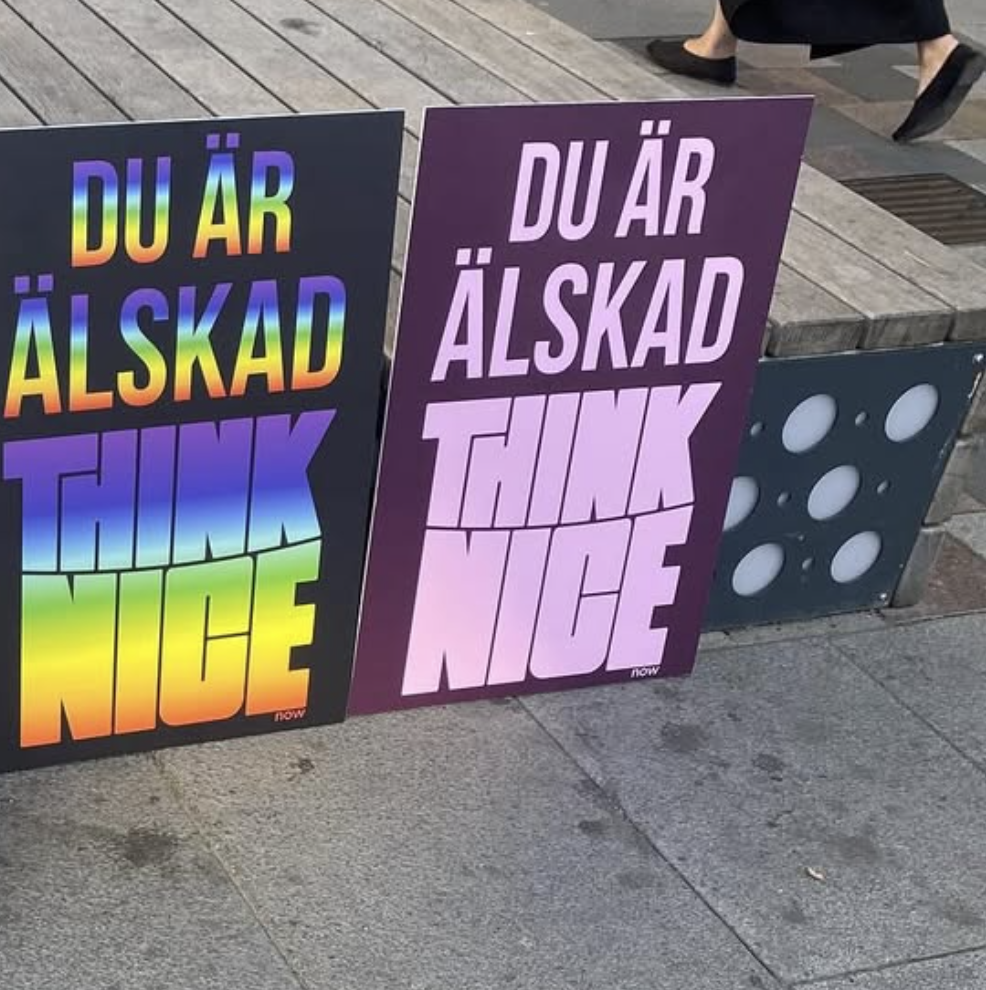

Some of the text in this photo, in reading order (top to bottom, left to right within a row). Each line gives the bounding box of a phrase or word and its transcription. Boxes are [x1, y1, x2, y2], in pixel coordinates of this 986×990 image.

[71, 132, 295, 268] DU ÄR
[508, 119, 715, 242] DU ÄR
[3, 273, 346, 419] ÄLSKAD
[430, 247, 744, 383] ÄLSKAD
[3, 408, 337, 573] THINK
[422, 381, 722, 529] THINK
[20, 538, 322, 748] NICE
[401, 505, 694, 697] NICE
[274, 709, 306, 722] now
[630, 666, 661, 678] now
